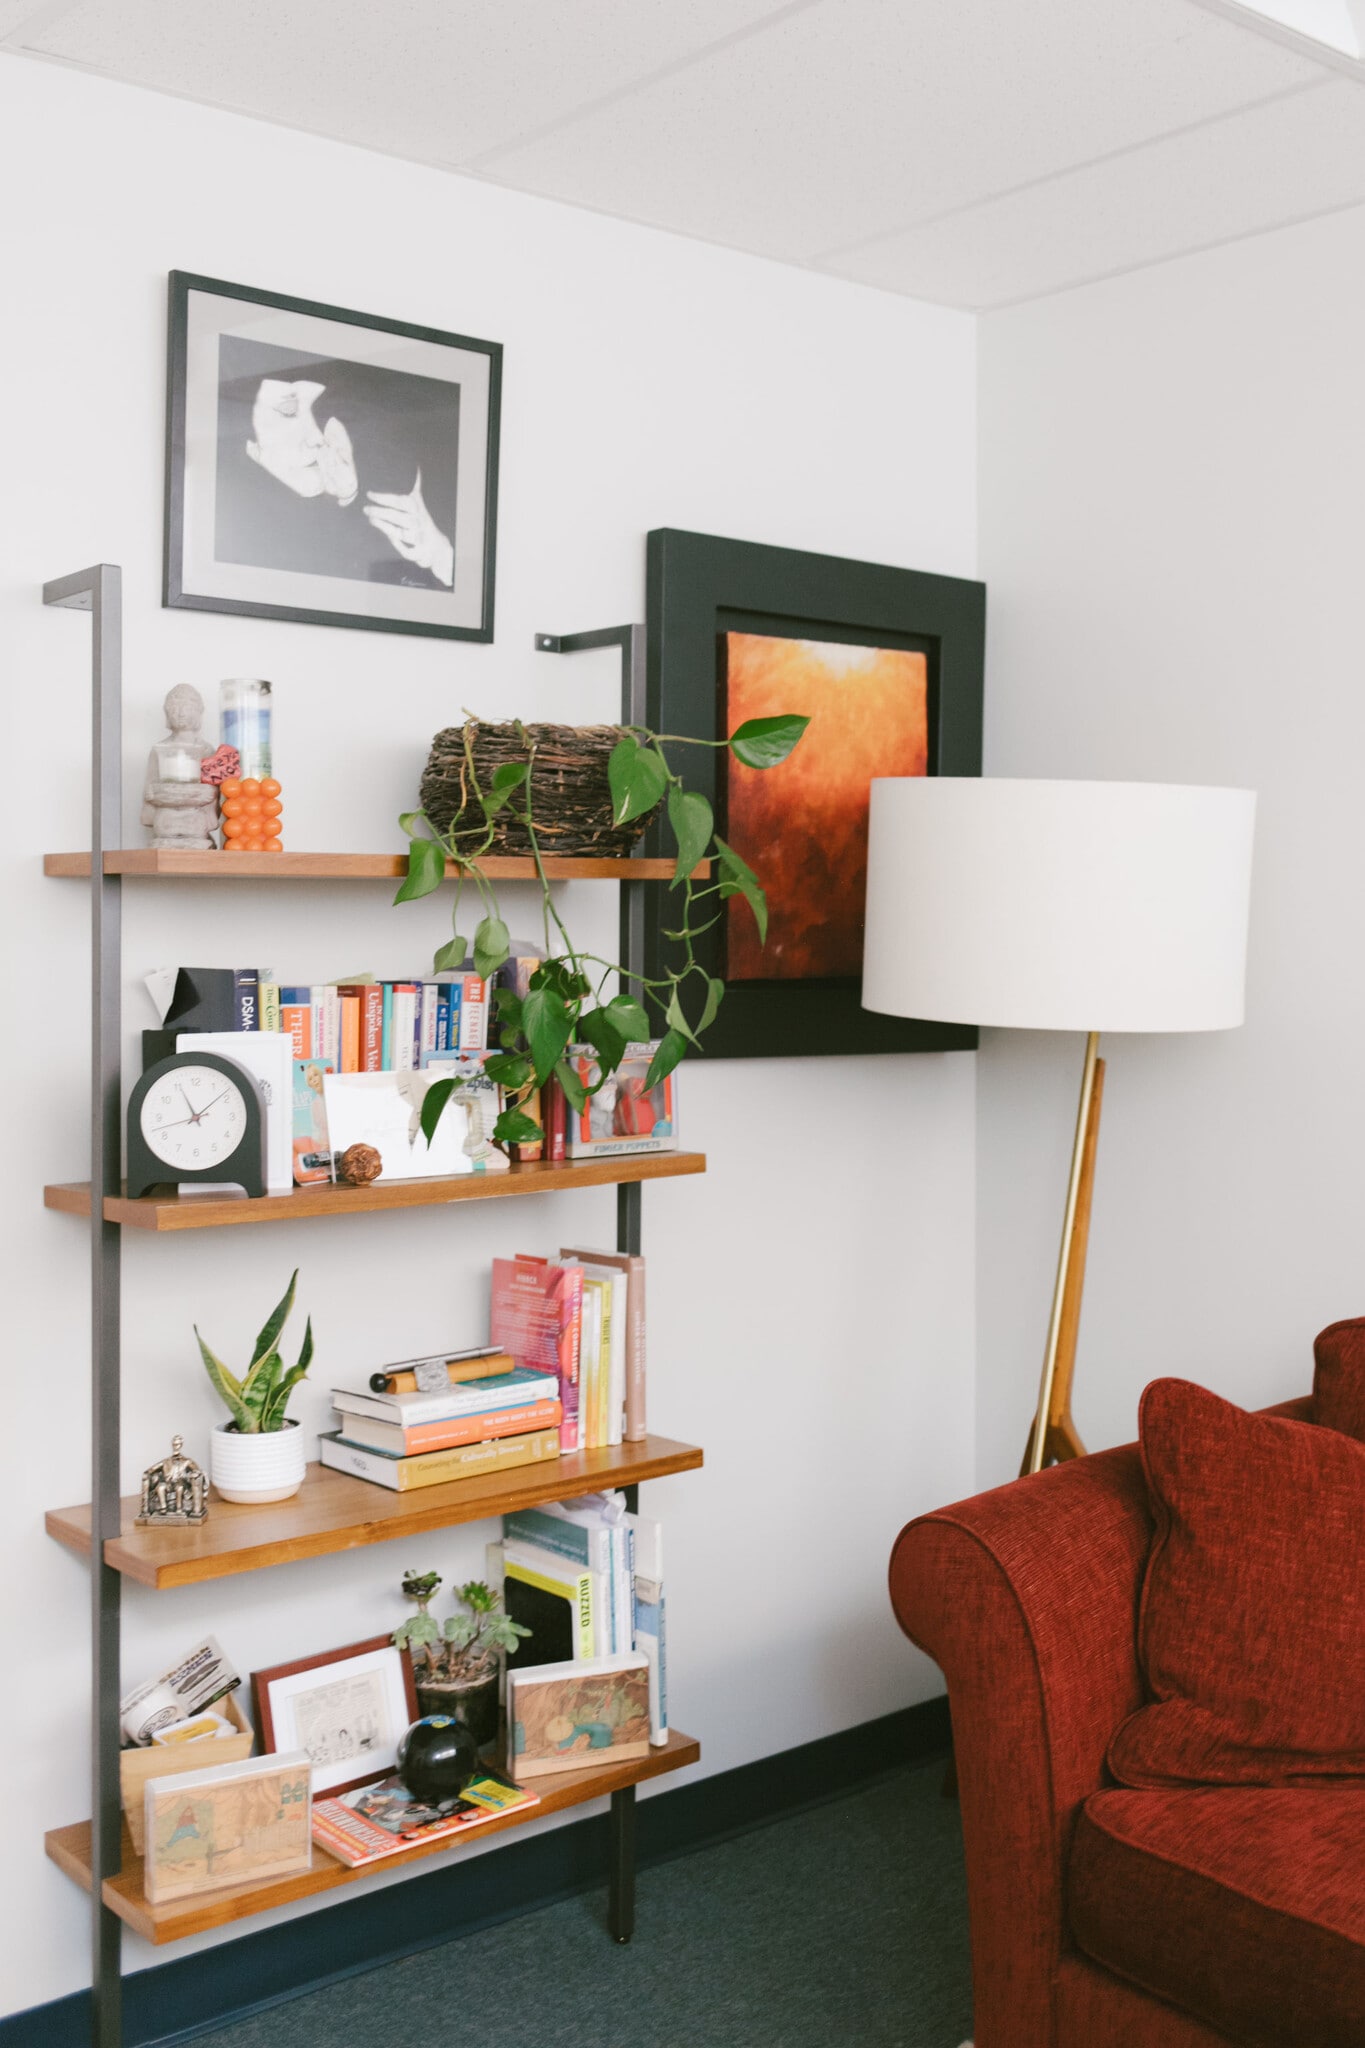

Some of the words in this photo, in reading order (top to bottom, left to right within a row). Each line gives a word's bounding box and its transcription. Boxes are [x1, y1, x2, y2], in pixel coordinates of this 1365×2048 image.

[241, 996, 254, 1033] DSM-
[365, 991, 379, 1048] Unspoken
[468, 1005, 480, 1045] TEENAGE
[625, 1140, 661, 1152] PUPPETS
[571, 1327, 579, 1384] COMPASSION
[580, 1578, 591, 1628] BUZZED
